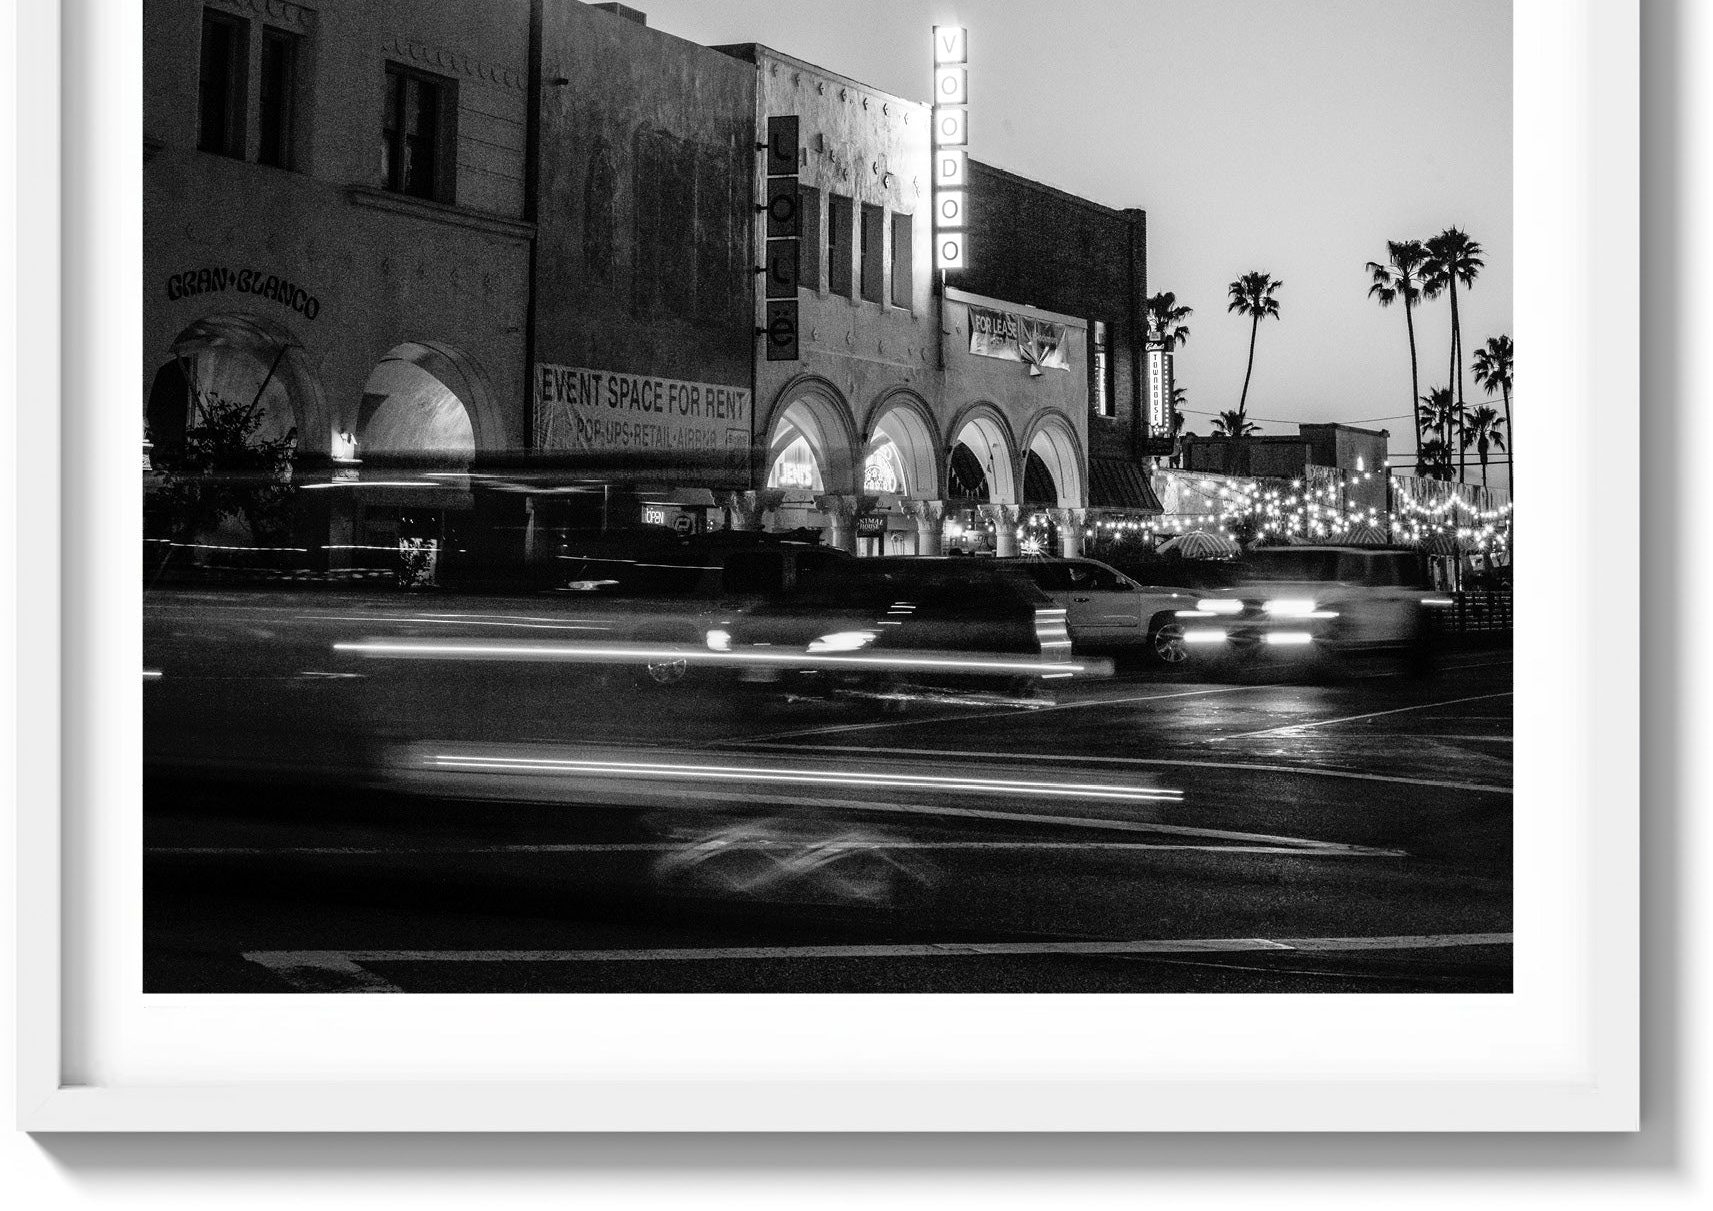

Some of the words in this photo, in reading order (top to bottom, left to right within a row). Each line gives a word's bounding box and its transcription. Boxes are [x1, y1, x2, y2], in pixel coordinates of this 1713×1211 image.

[941, 35, 958, 261] VOODOO
[975, 314, 992, 333] FOR
[993, 317, 1018, 339] LEASE
[542, 368, 602, 406] EVENT
[608, 375, 663, 413] SPACE
[669, 383, 699, 416] FOR
[705, 388, 746, 420] RENT
[646, 510, 664, 524] OPEN
